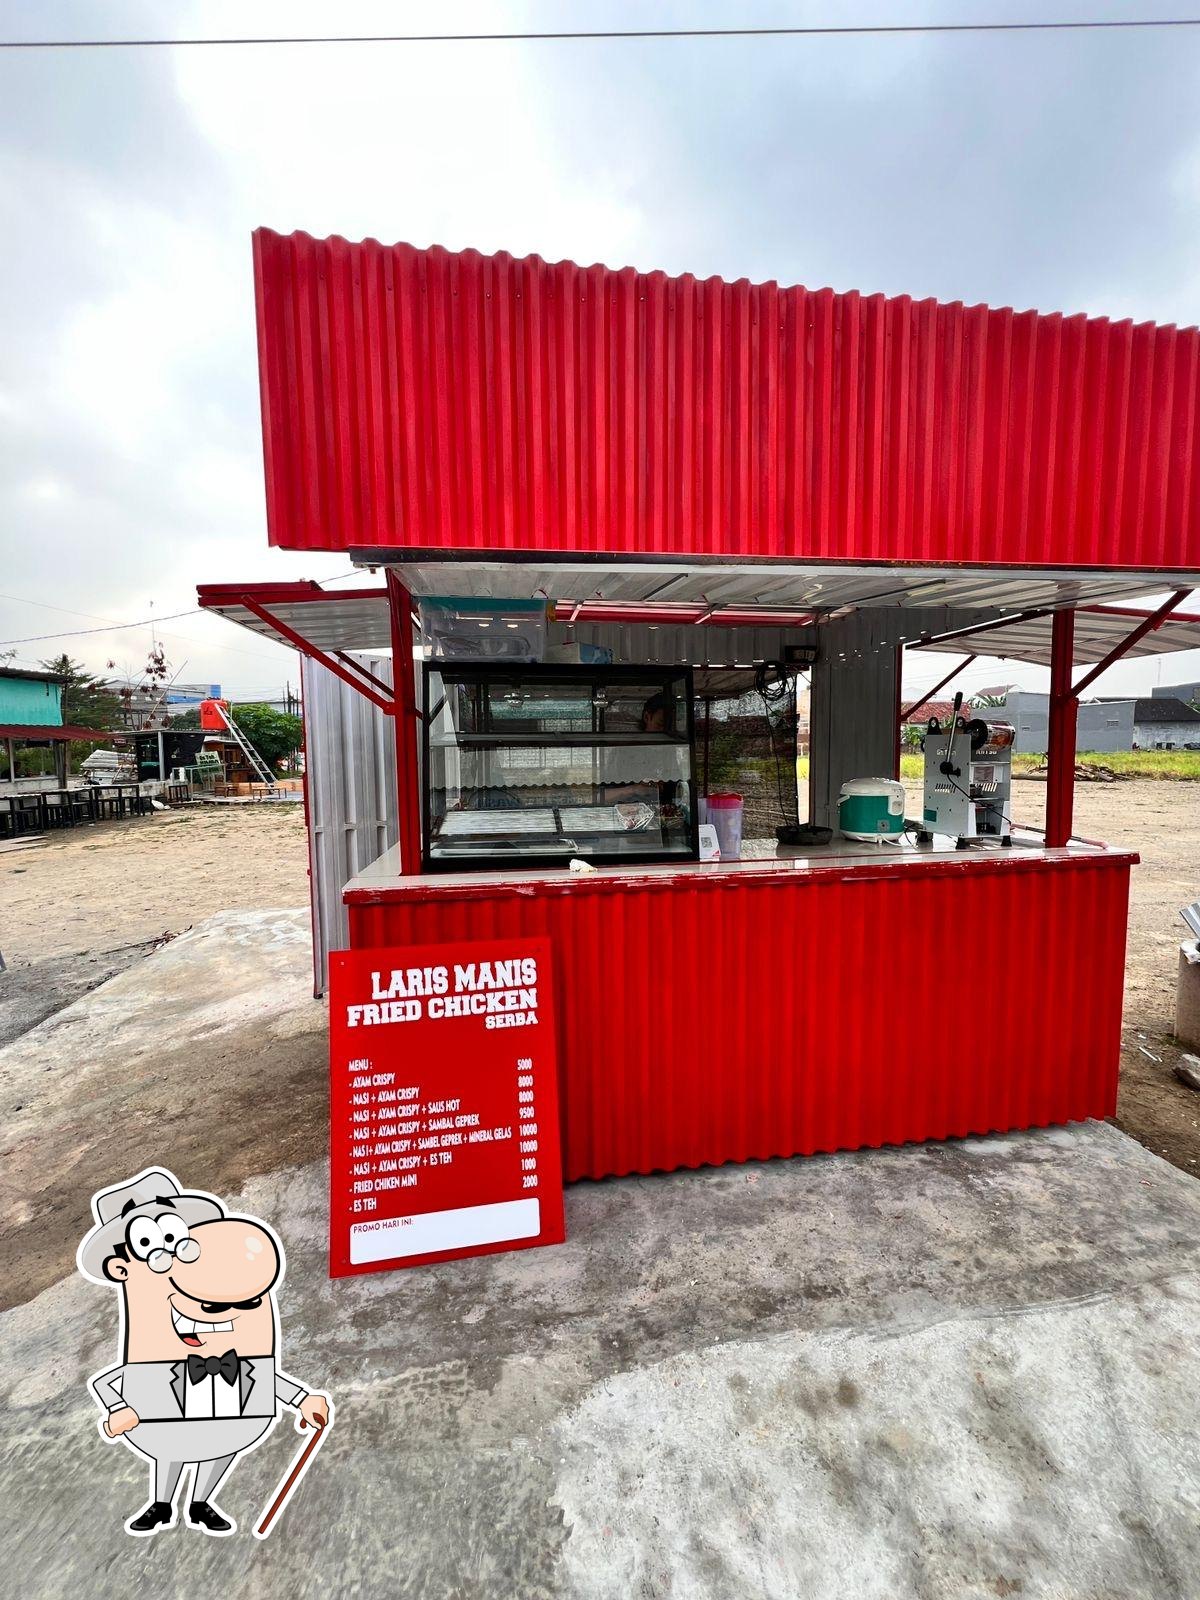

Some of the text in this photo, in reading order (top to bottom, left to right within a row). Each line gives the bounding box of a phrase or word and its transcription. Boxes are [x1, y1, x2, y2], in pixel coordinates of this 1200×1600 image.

[371, 958, 537, 1000] LARIS MANIS
[347, 988, 538, 1027] FRIED CHICKEN
[485, 1011, 538, 1029] SERBA
[348, 1059, 368, 1072] MENU
[517, 1058, 532, 1070] 5000
[352, 1076, 371, 1088] AYAM
[372, 1072, 395, 1086] CRISPY
[518, 1075, 533, 1087] 8000
[353, 1092, 369, 1105] NASI
[378, 1090, 396, 1102] AYAM
[397, 1086, 420, 1100] CRISPY
[519, 1090, 533, 1103] 8000
[353, 1109, 369, 1122] NASI
[378, 1107, 396, 1120] AYAM
[397, 1103, 420, 1117] CRISPY
[428, 1100, 445, 1114] SAUS
[446, 1099, 460, 1112] HOT
[519, 1106, 535, 1119] 9500
[353, 1127, 369, 1140] NASI
[378, 1124, 397, 1137] AYAM
[397, 1121, 420, 1135] CRISPY
[428, 1117, 454, 1131] SAMBAL
[455, 1113, 480, 1128] GEPREK
[519, 1123, 538, 1137] 10000
[374, 1142, 391, 1155] AYAM
[391, 1139, 411, 1153] CRISPY
[441, 1133, 462, 1147] GEPREK
[468, 1129, 493, 1143] MINERAL
[494, 1126, 512, 1140] GELAS
[520, 1140, 538, 1153] 10000
[353, 1162, 370, 1175] NASI
[378, 1159, 397, 1172] AYAM
[398, 1156, 421, 1170] CRISPY
[430, 1153, 438, 1166] ES
[439, 1151, 452, 1164] TEH
[521, 1157, 536, 1170] 1000
[353, 1180, 373, 1194] FRIED
[374, 1176, 400, 1191] CHIKEN
[401, 1174, 418, 1187] MINI
[522, 1174, 538, 1188] 2000
[353, 1199, 362, 1212] ES
[363, 1197, 377, 1211] TEH
[353, 1223, 380, 1233] PROMO
[382, 1219, 399, 1229] HARI
